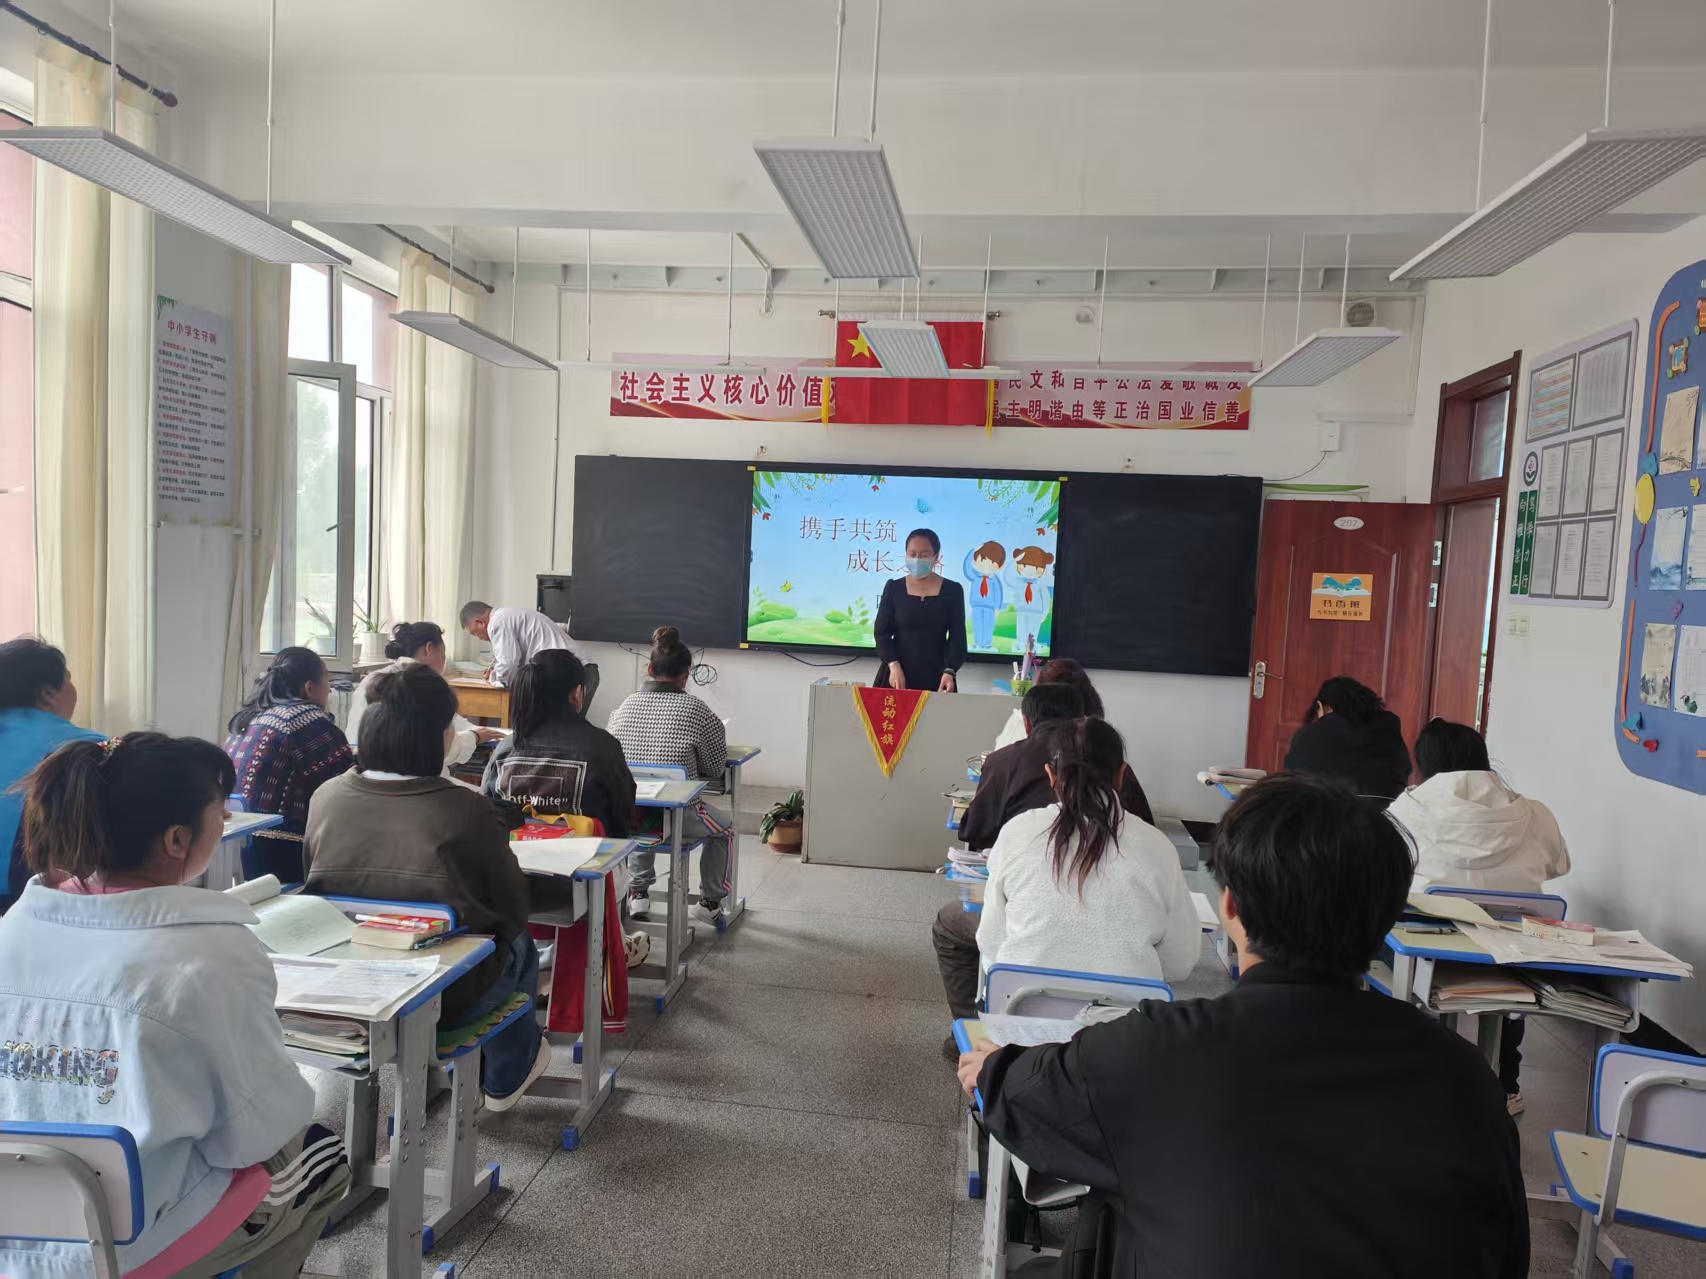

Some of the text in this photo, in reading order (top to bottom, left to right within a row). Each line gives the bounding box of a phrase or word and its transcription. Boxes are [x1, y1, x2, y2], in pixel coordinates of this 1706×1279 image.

[620, 371, 835, 407] 社会主义核心价值
[799, 514, 897, 543] 携手共筑
[1340, 519, 1358, 528] 207
[880, 695, 897, 746] 流动红旗
